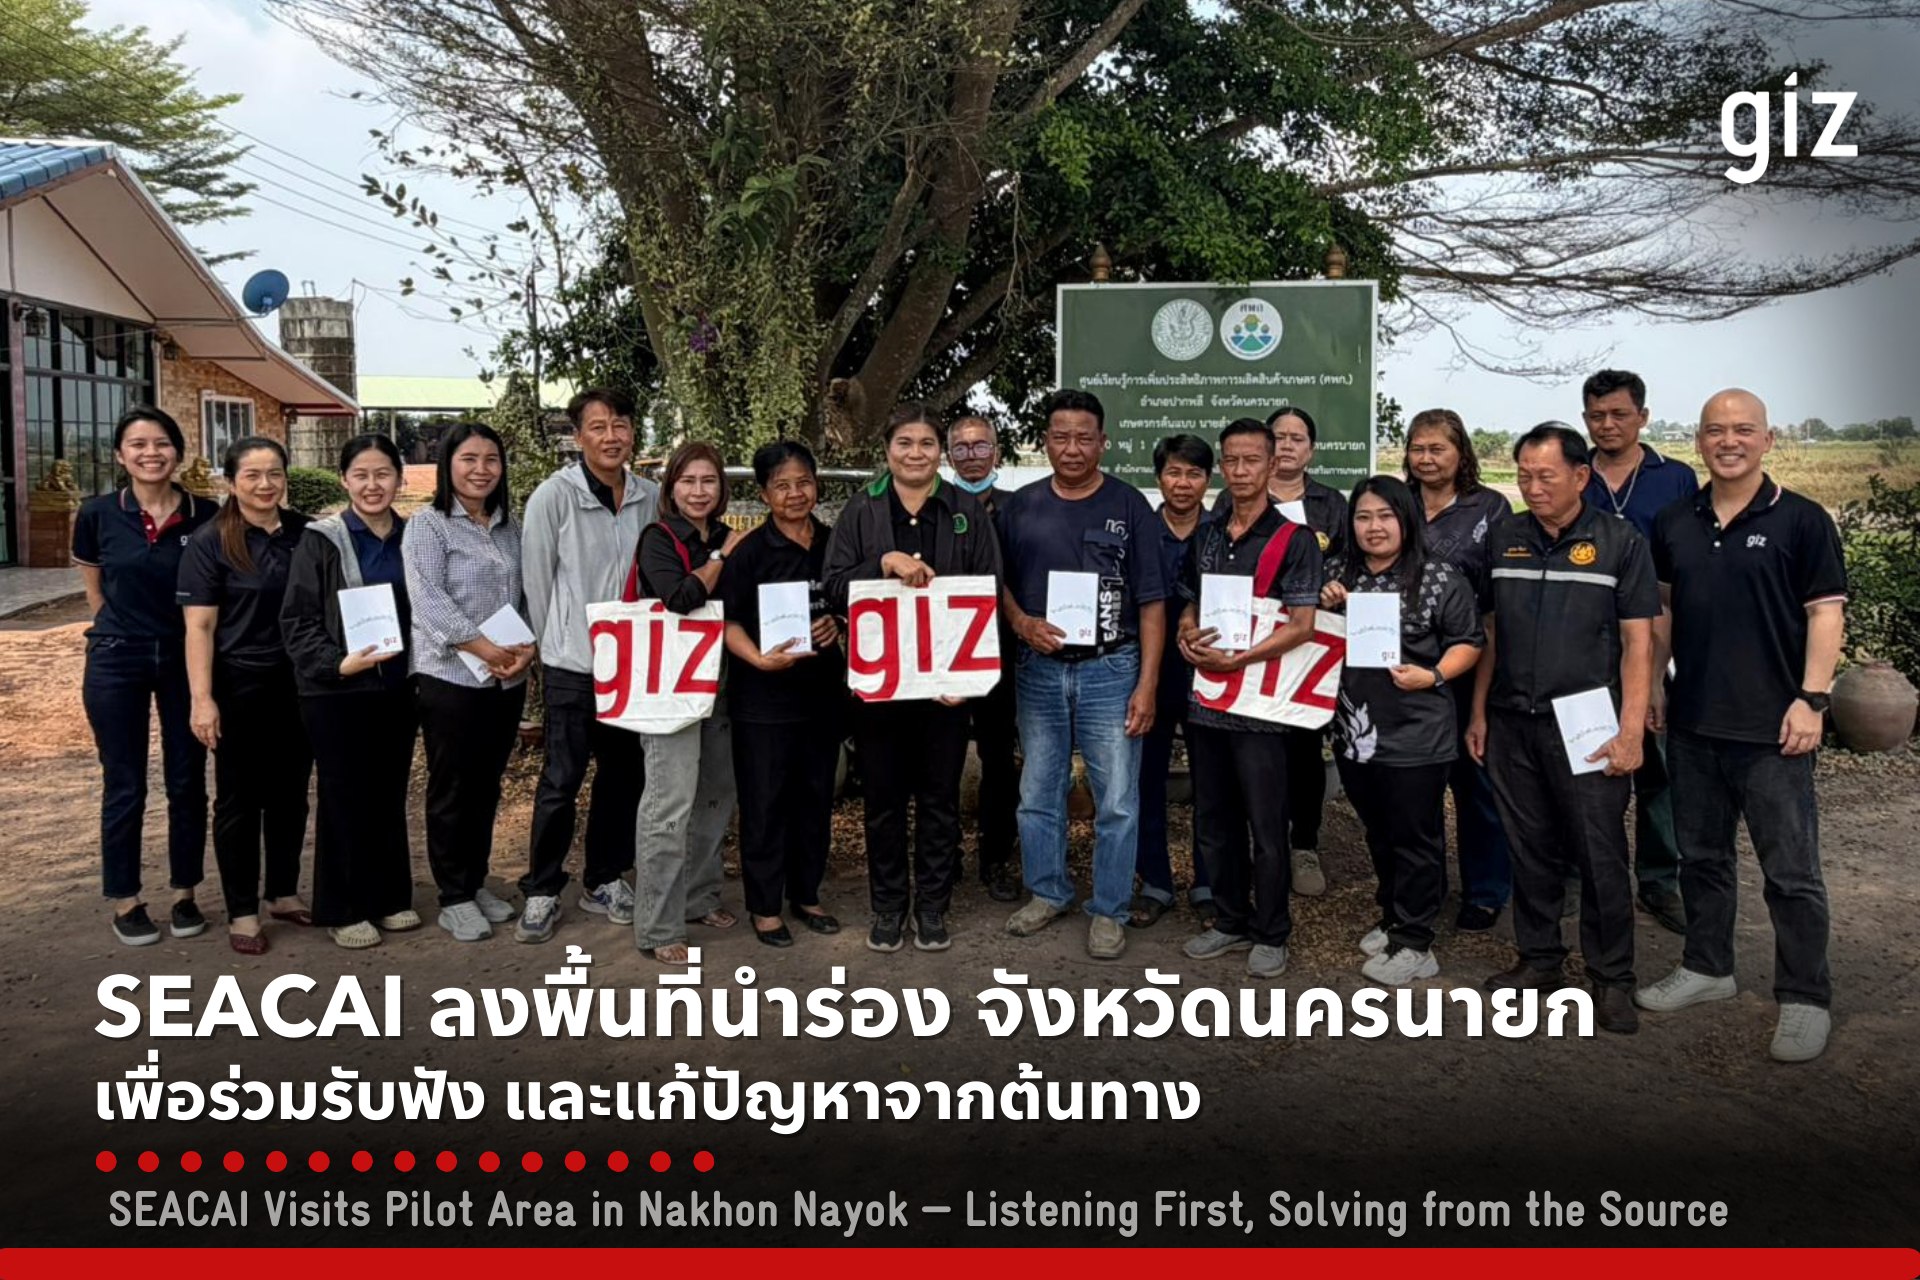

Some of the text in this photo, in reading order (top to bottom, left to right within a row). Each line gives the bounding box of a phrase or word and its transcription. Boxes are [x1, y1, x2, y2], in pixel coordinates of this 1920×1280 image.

[1210, 394, 1289, 407] จังหวัดนครนายก
[1746, 534, 1767, 548] giz
[849, 582, 1001, 701] giz
[589, 603, 725, 719] giz
[1381, 650, 1396, 662] giz
